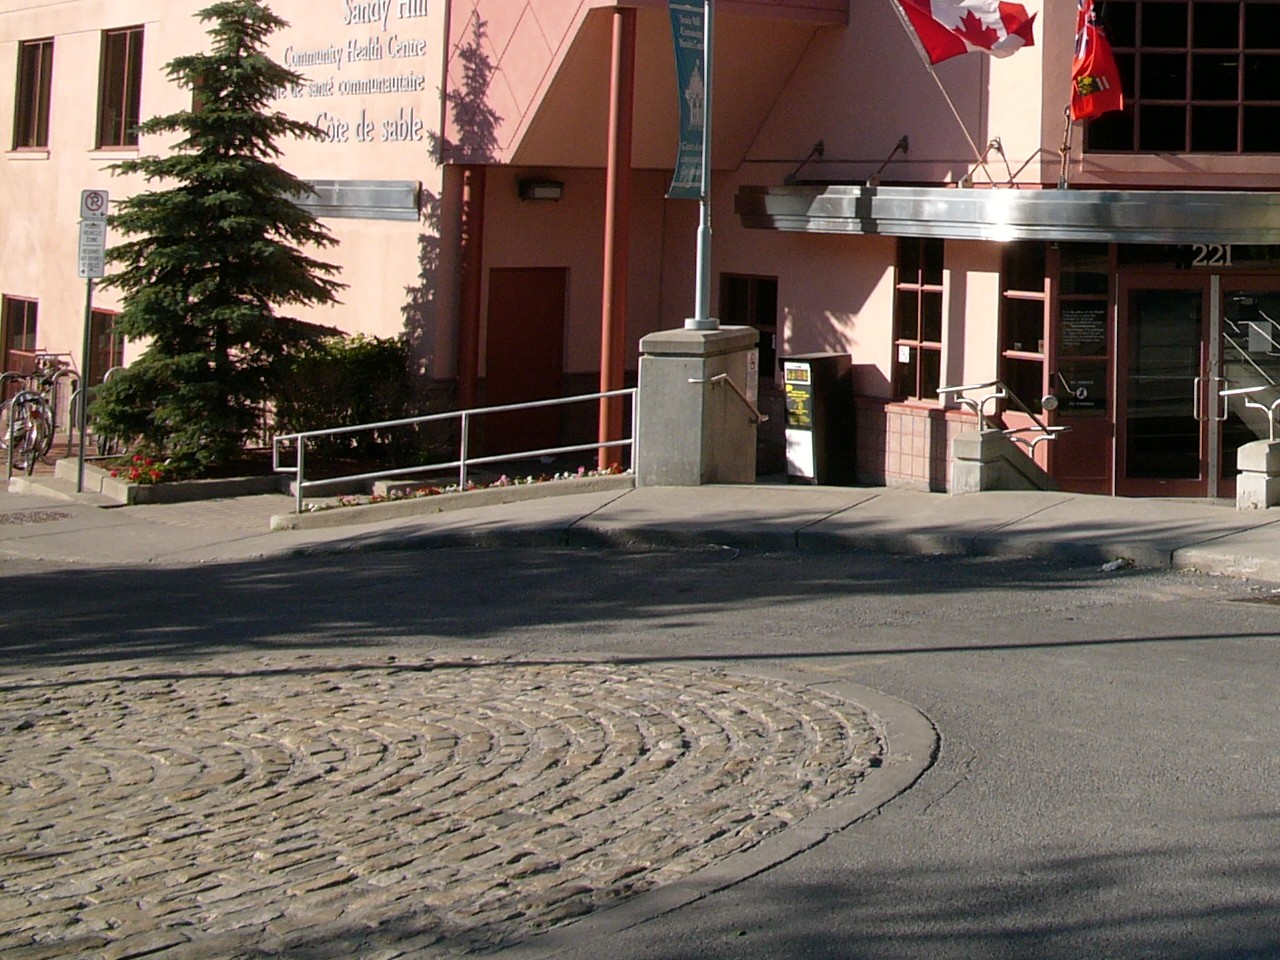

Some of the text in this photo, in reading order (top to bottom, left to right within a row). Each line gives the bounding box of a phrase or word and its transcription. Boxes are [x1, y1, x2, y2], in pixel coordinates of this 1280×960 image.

[283, 34, 427, 70] Community Health Centre
[308, 76, 334, 98] santé
[338, 70, 426, 95] communautaire
[315, 106, 424, 143] Côte de sable
[1192, 244, 1233, 267] 221
